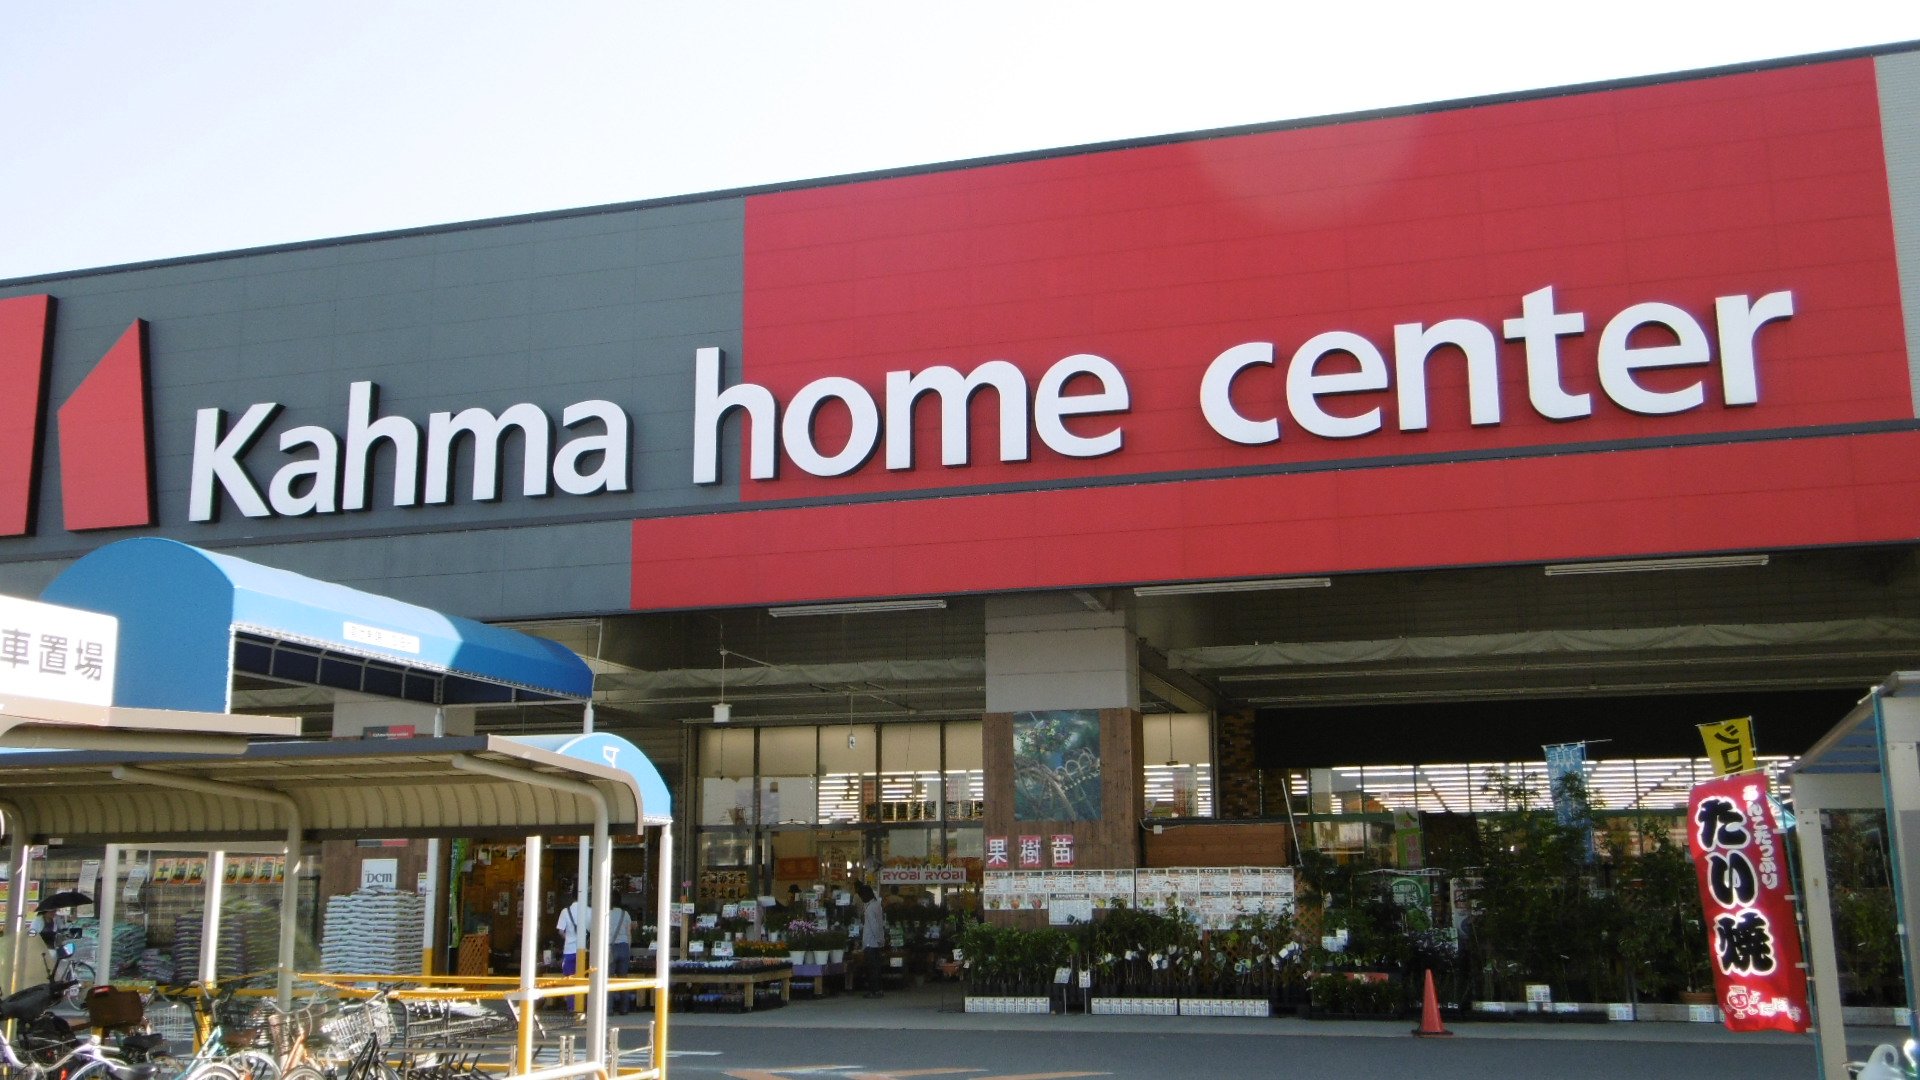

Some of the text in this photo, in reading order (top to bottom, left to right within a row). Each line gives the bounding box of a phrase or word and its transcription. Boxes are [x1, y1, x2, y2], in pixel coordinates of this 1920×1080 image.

[189, 286, 1793, 522] Kahma home center
[0, 628, 103, 681] 車置場
[882, 870, 963, 881] RYOBI RYOBI
[987, 838, 1073, 864] 果樹苗
[1694, 796, 1777, 976] たい焼
